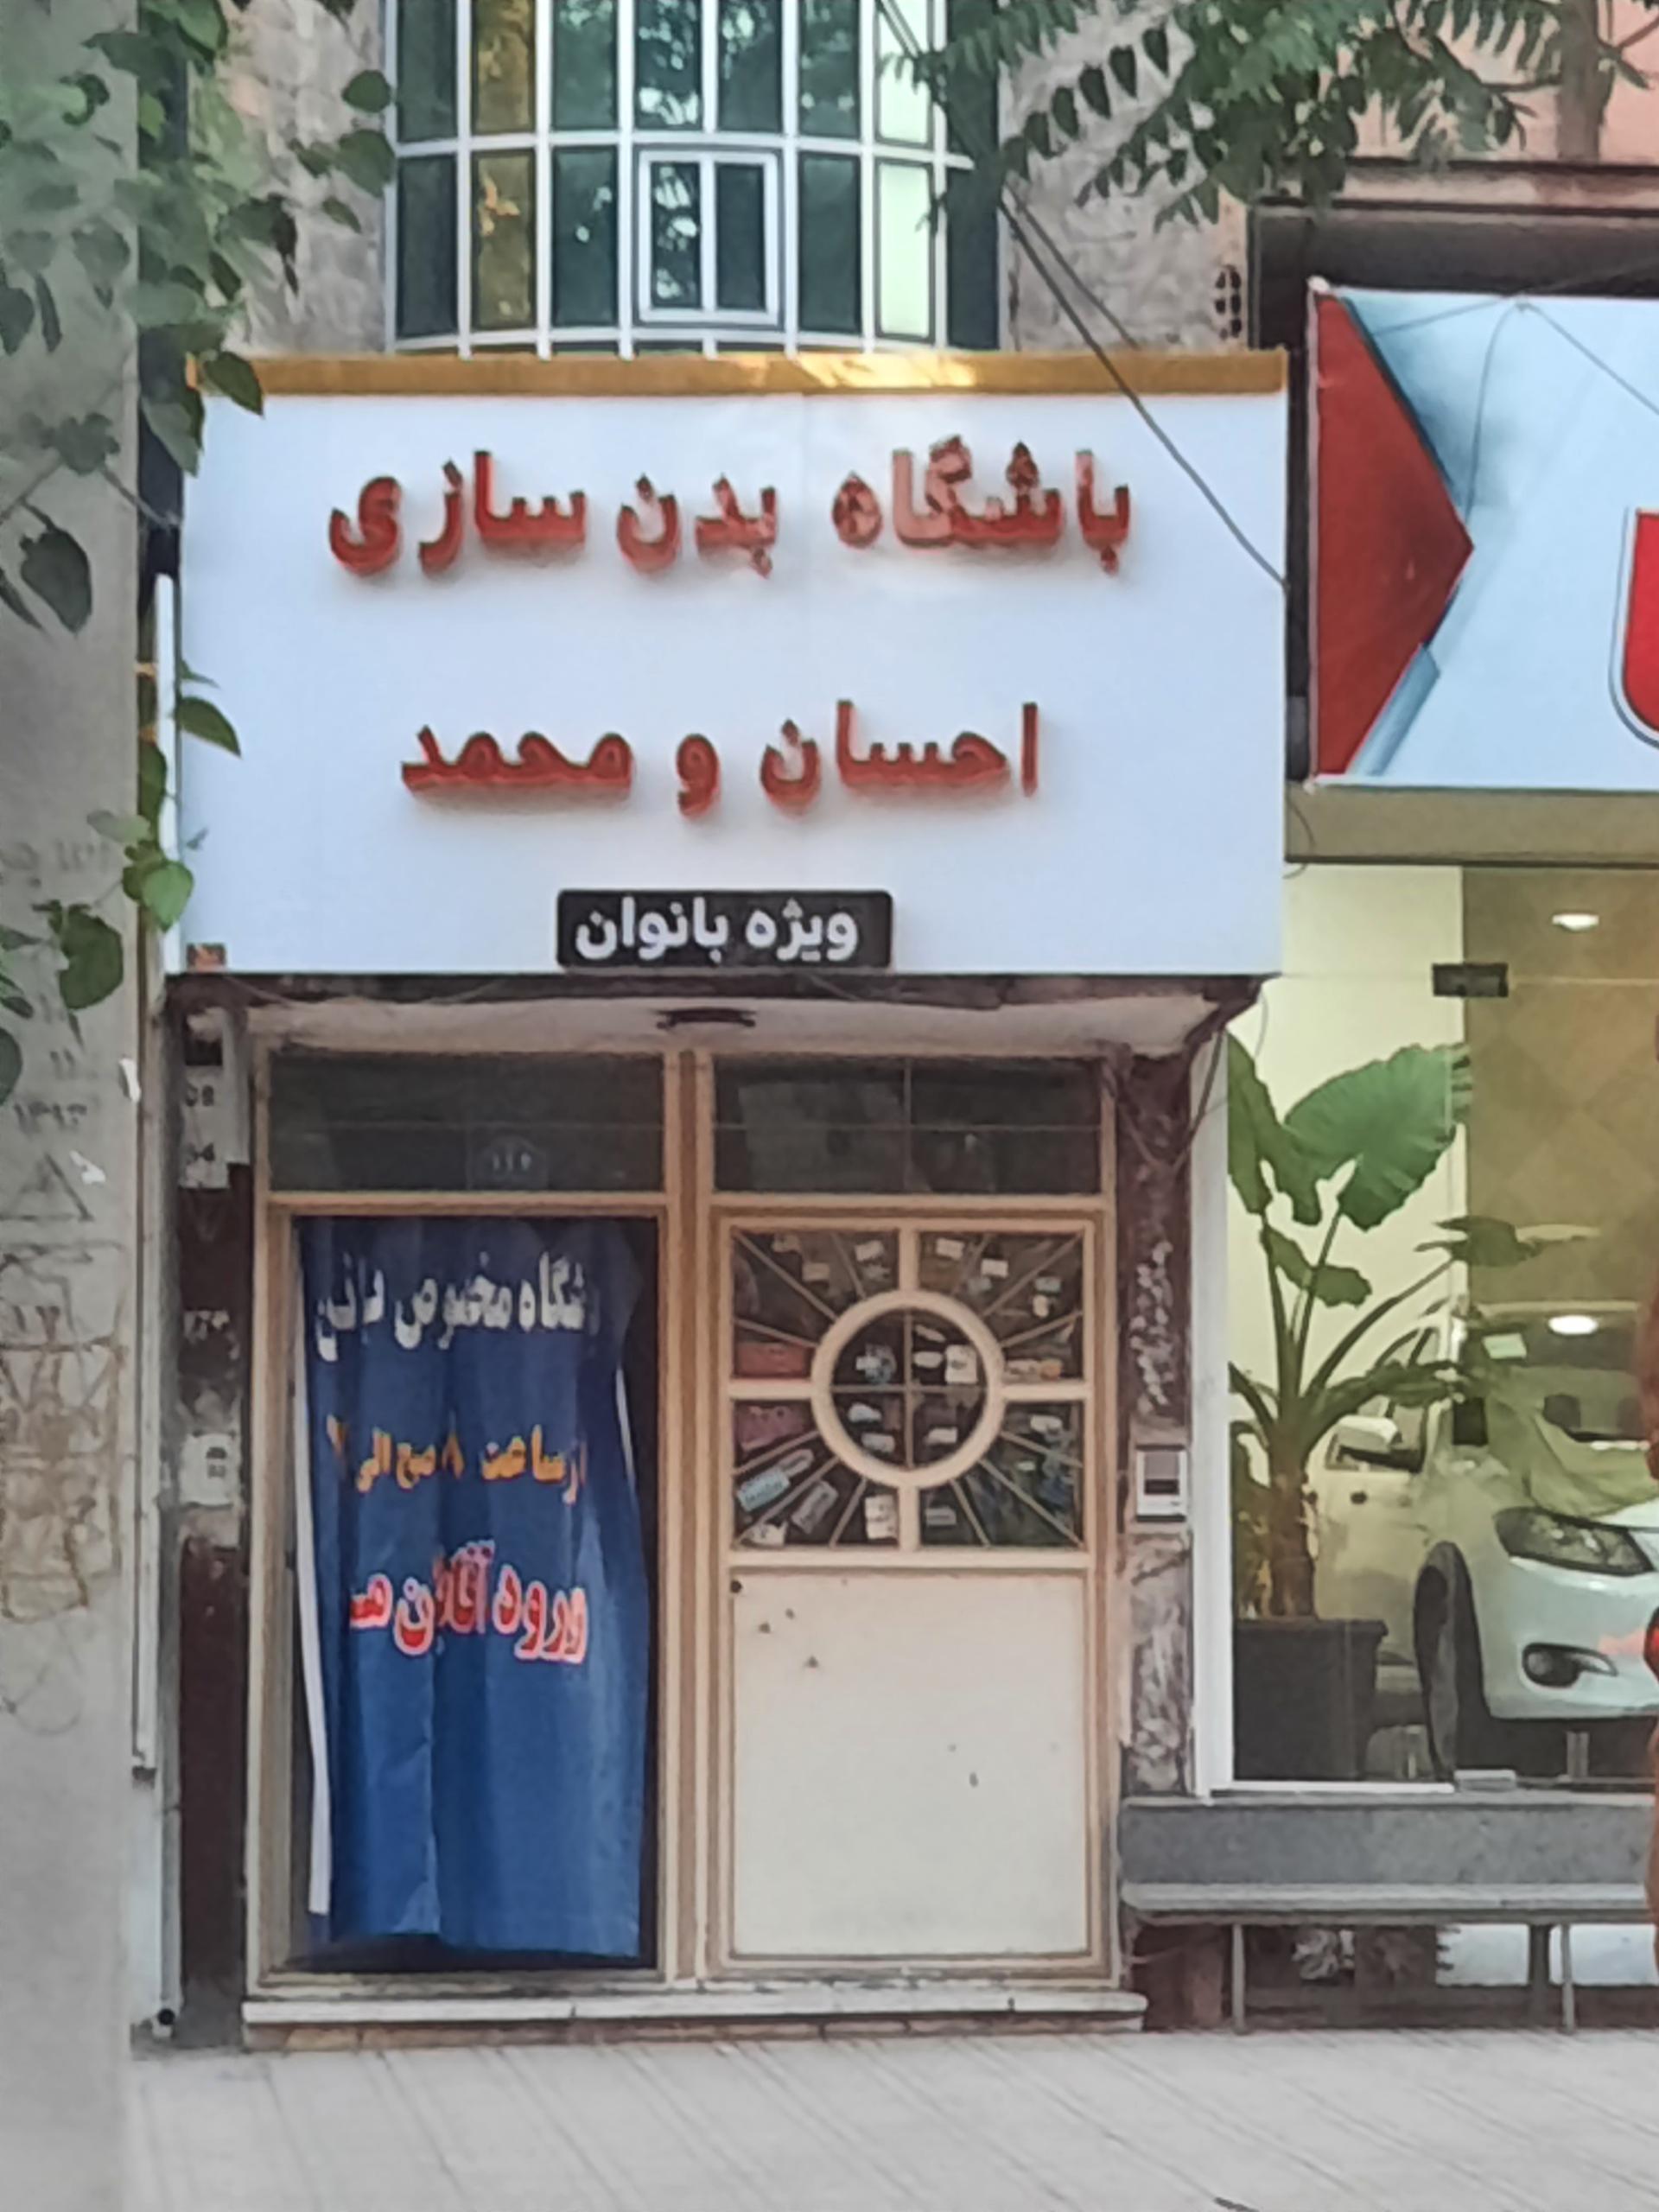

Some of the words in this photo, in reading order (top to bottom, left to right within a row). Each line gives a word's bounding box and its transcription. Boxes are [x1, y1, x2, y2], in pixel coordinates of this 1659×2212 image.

[330, 450, 587, 575] سازی
[616, 474, 777, 576] بدن
[832, 435, 1131, 575] باشگاه
[402, 727, 633, 799] محمد
[677, 733, 721, 818] و
[760, 699, 1039, 816] احسان
[577, 898, 728, 962] بانوان
[747, 901, 857, 960] ویژه
[492, 1563, 588, 1664] ورود
